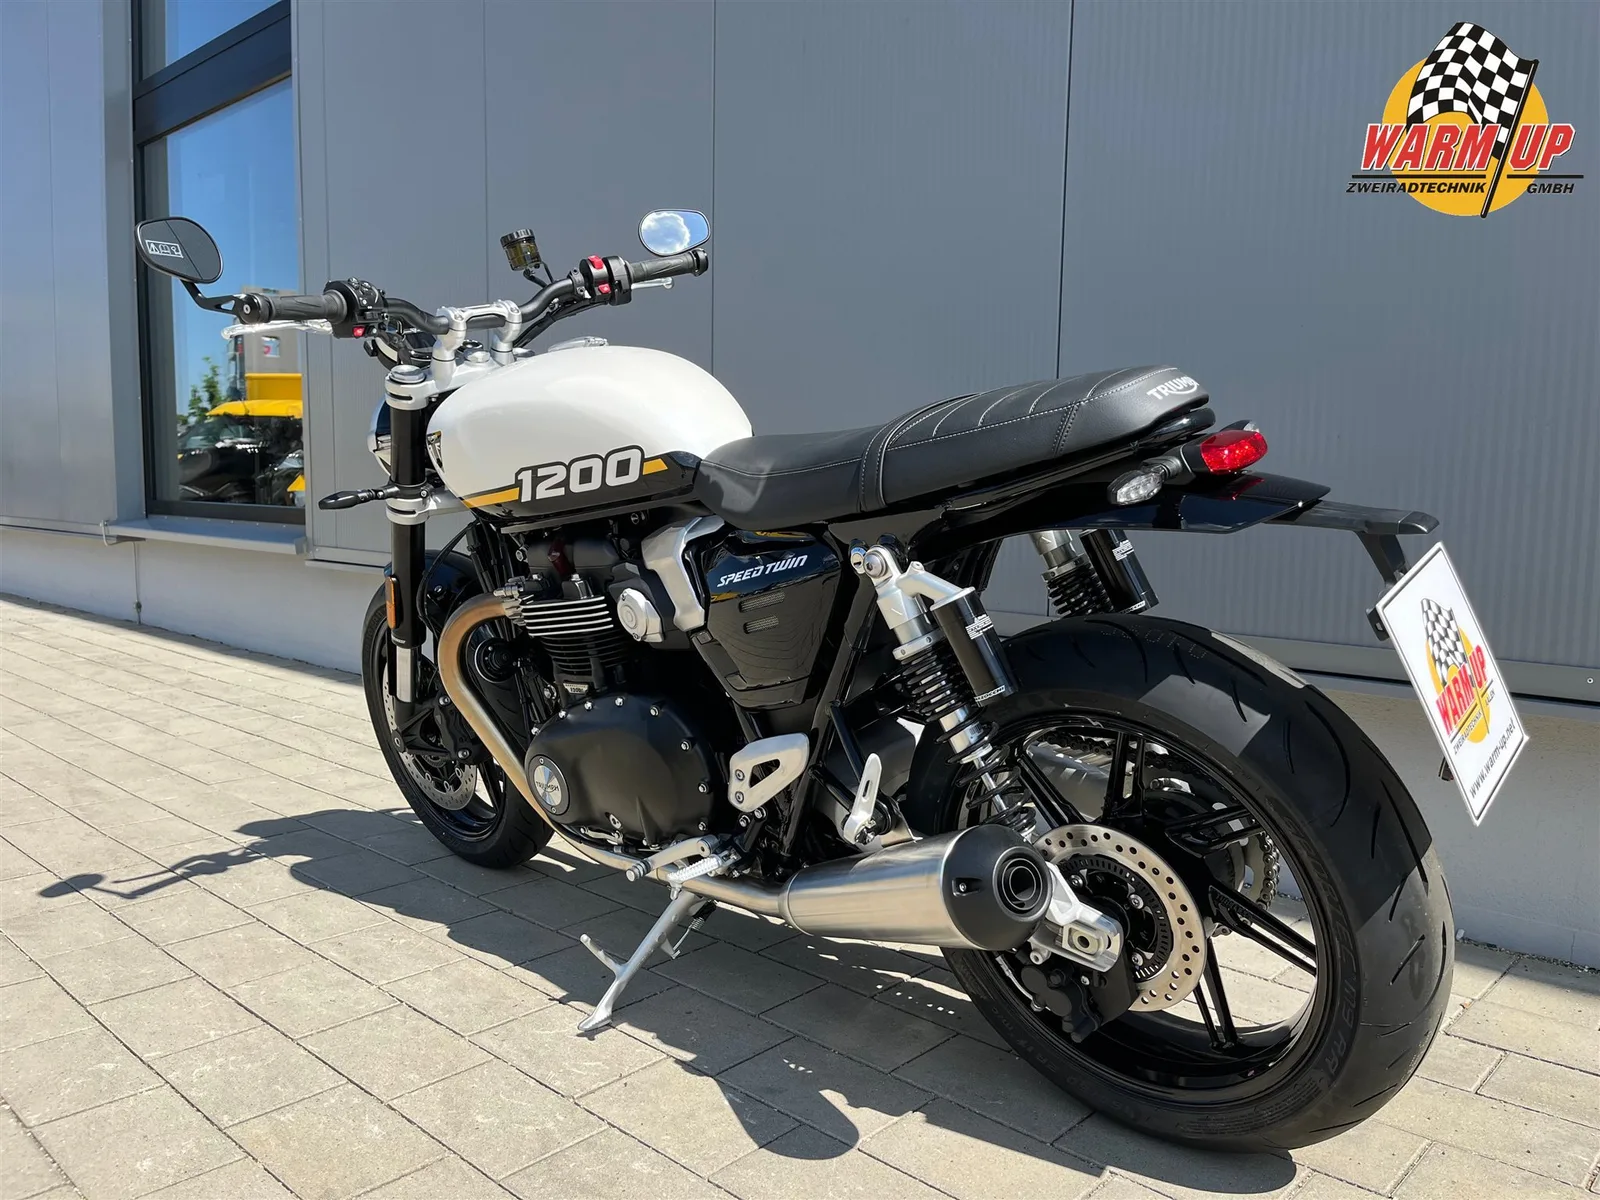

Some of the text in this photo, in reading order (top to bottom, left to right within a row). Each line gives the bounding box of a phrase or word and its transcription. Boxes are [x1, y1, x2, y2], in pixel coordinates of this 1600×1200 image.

[517, 447, 643, 503] 1200
[717, 554, 808, 588] SPEED TWIN
[1435, 645, 1488, 736] WARM UP
[1468, 717, 1516, 799] www.warm-up.net
